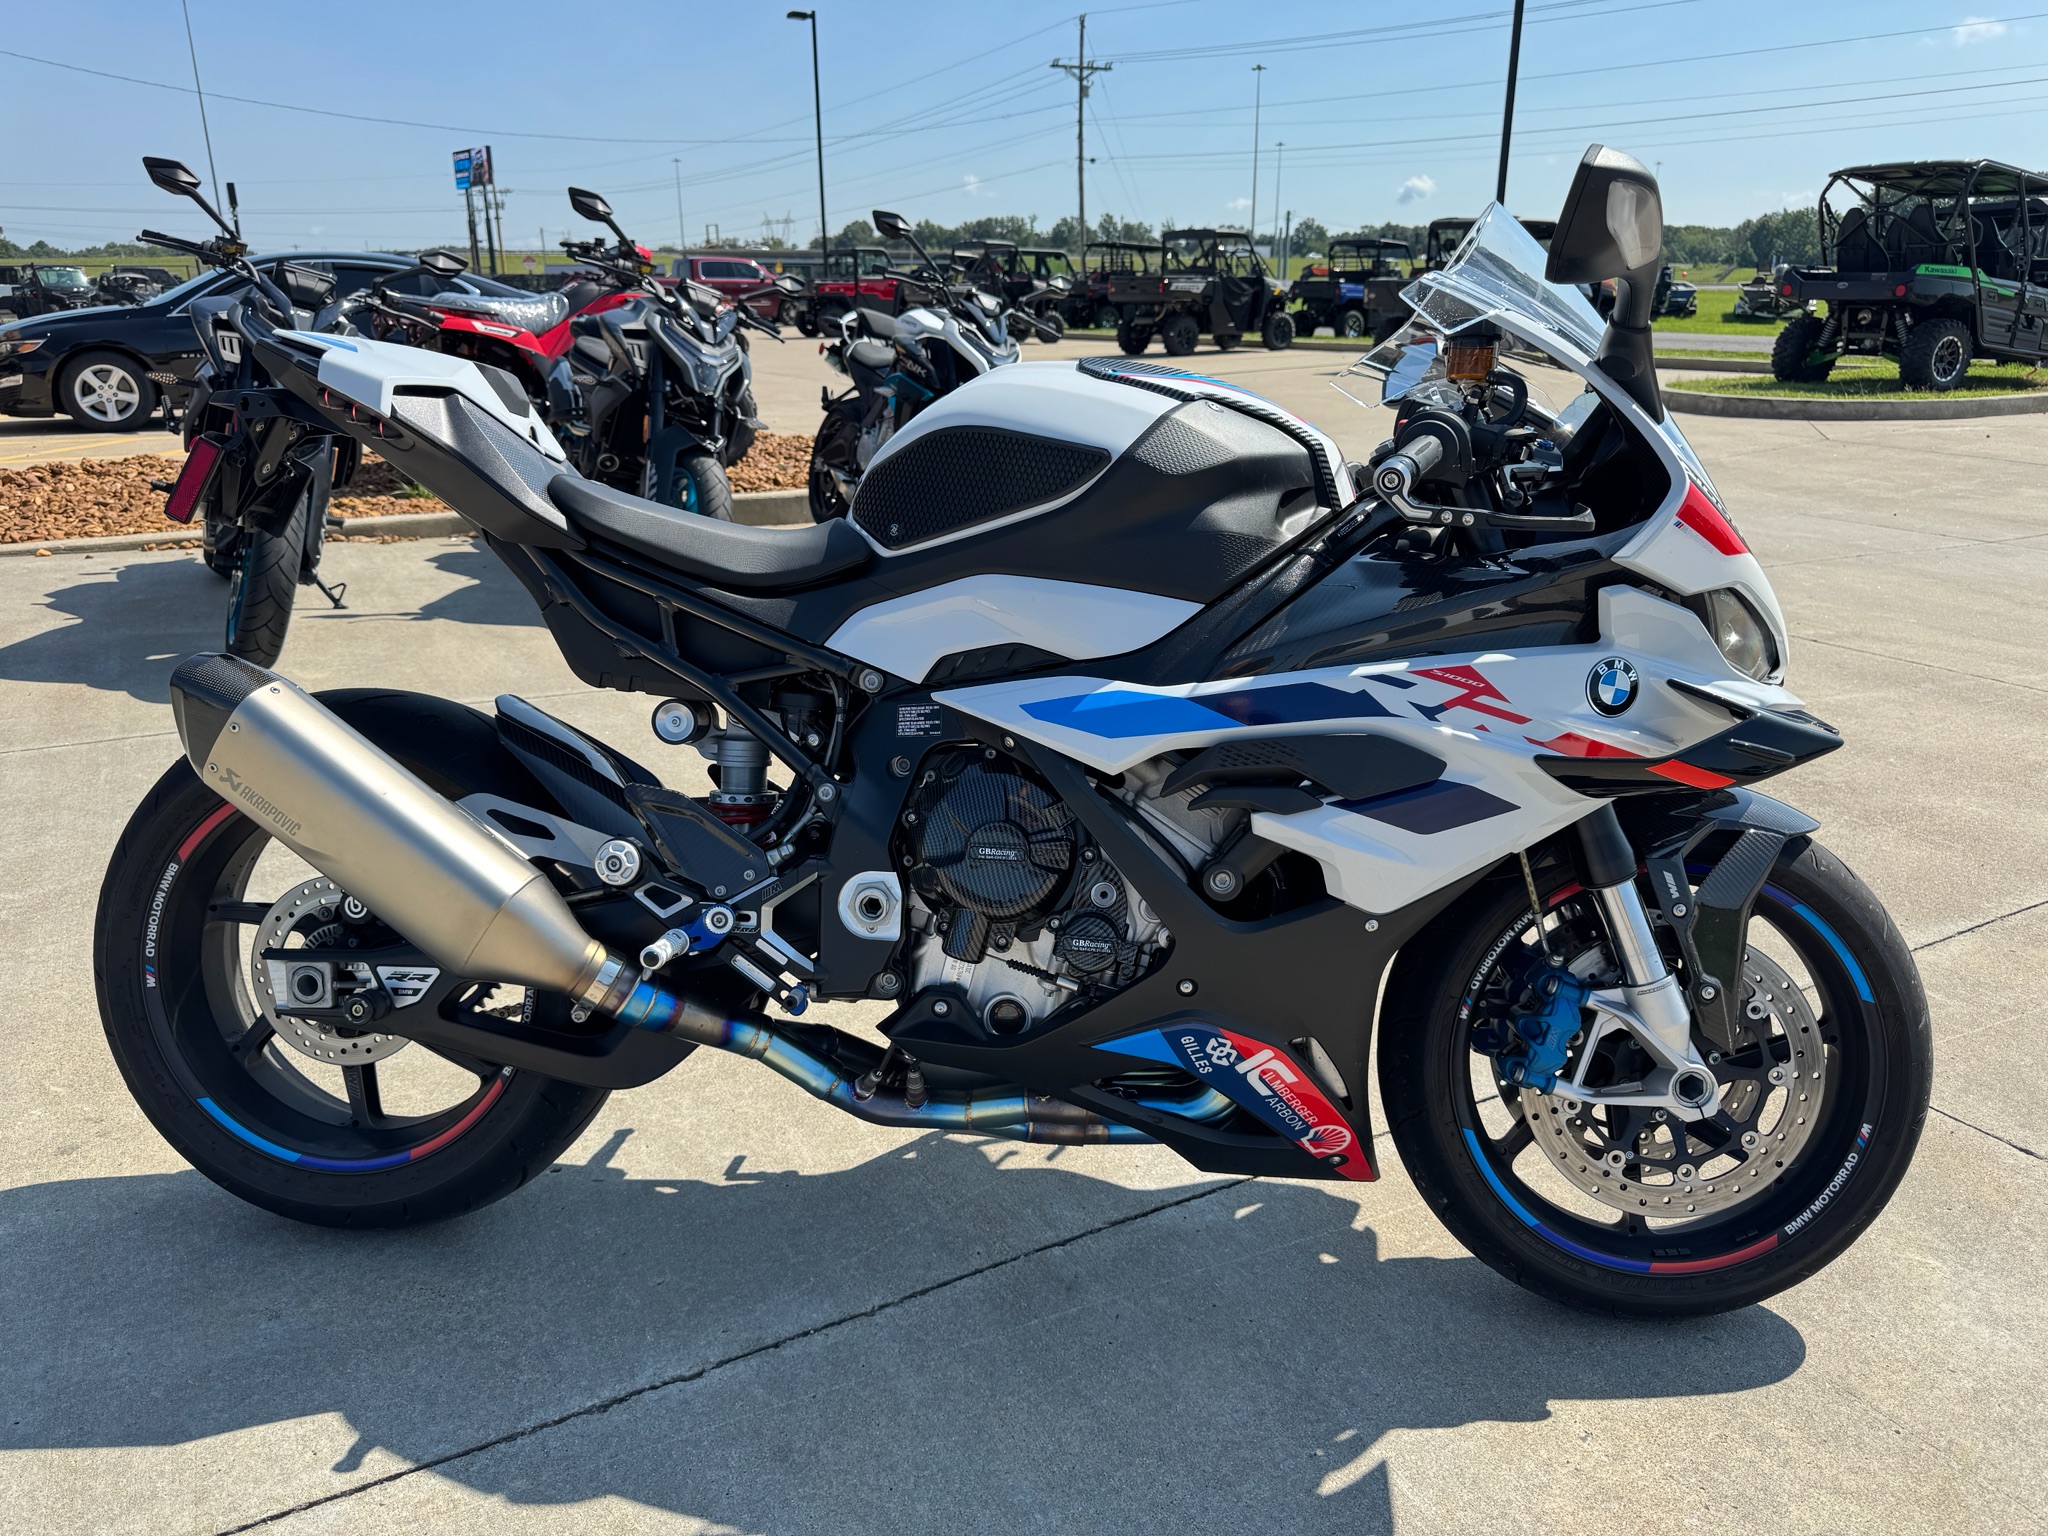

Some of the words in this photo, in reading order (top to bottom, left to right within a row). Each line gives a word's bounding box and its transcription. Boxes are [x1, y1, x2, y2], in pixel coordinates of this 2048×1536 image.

[1924, 265, 1958, 275] Kawasaki
[1429, 669, 1486, 688] S1000
[1597, 660, 1638, 681] BMW
[979, 848, 1015, 858] GBRacing
[160, 862, 179, 891] BMW
[145, 890, 166, 958] MOTORRAD
[1513, 909, 1534, 932] MW
[1072, 939, 1109, 950] GBRacing
[1470, 929, 1516, 990] MOTORRAD
[385, 973, 434, 983] RR
[1180, 1035, 1213, 1074] GILLES
[1262, 1072, 1319, 1126] ILMBERGER
[1265, 1094, 1306, 1131] ARBON
[1784, 1209, 1813, 1235] BMW
[1810, 1152, 1859, 1214] MOTORRAD
